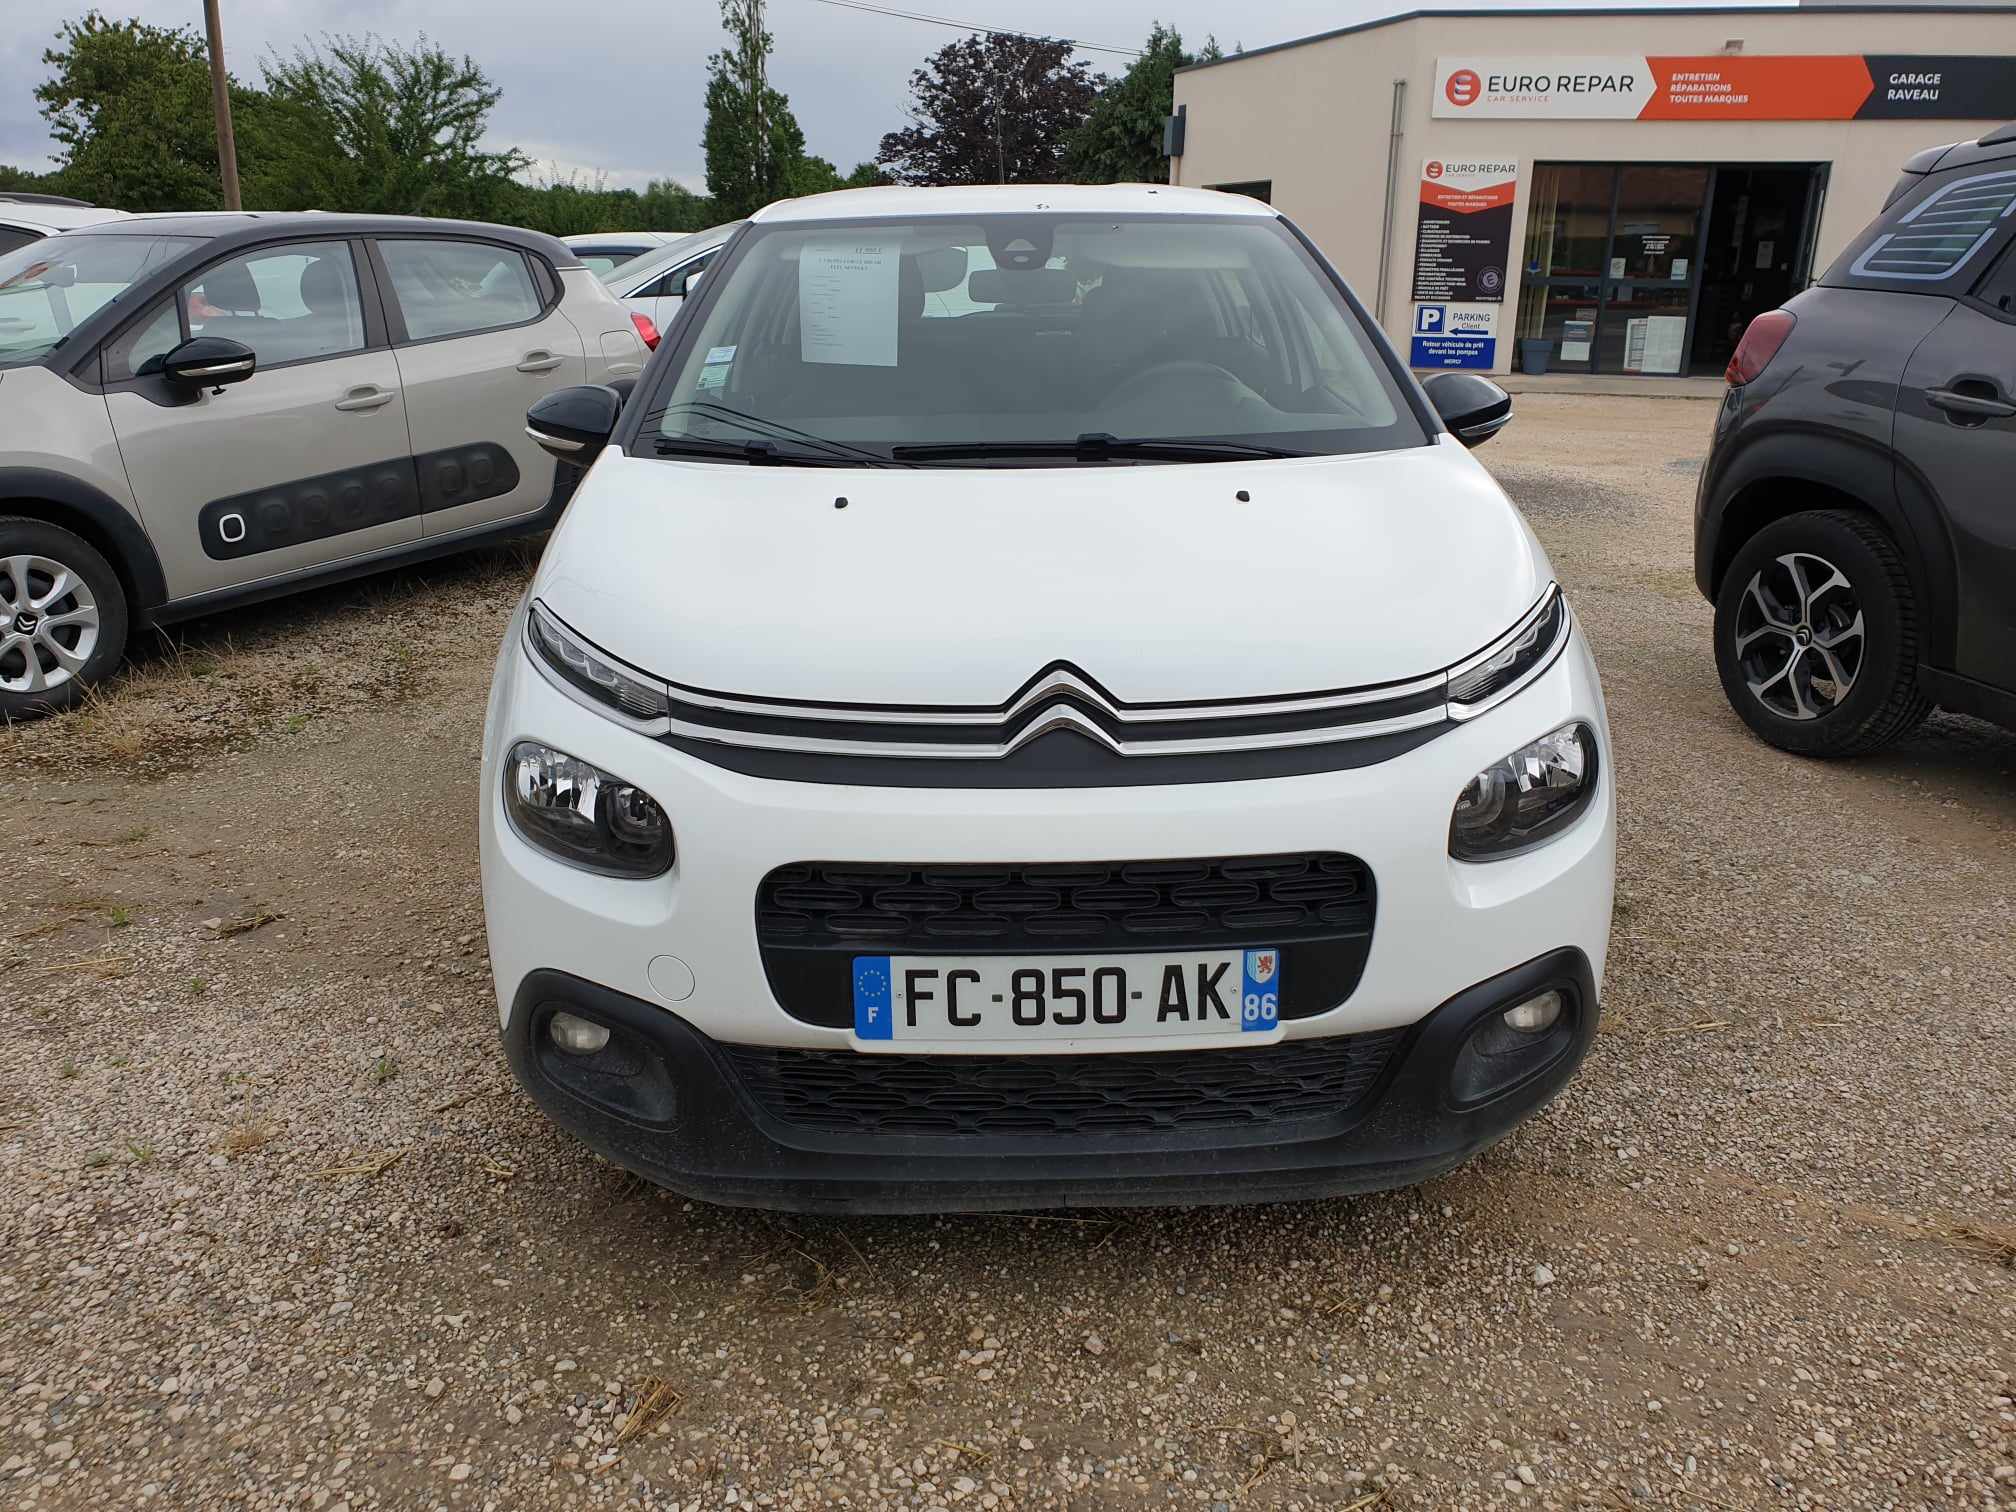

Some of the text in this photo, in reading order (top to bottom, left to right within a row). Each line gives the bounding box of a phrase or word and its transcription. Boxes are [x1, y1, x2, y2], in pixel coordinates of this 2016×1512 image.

[1672, 73, 1720, 81] ENTRETIEN
[1889, 73, 1941, 84] GARAGE
[1487, 75, 1634, 93] EURO REPAR
[1670, 82, 1732, 92] RÉPARATIONS
[1669, 94, 1749, 104] TOUTES MARQUES
[1887, 89, 1939, 100] RAVEAU
[1445, 163, 1516, 173] EURO REPAR
[1421, 308, 1440, 330] P
[1453, 312, 1491, 322] PARKING
[905, 962, 1231, 1026] FC-850-AK
[1243, 993, 1278, 1022] 86
[867, 1006, 879, 1024] F
